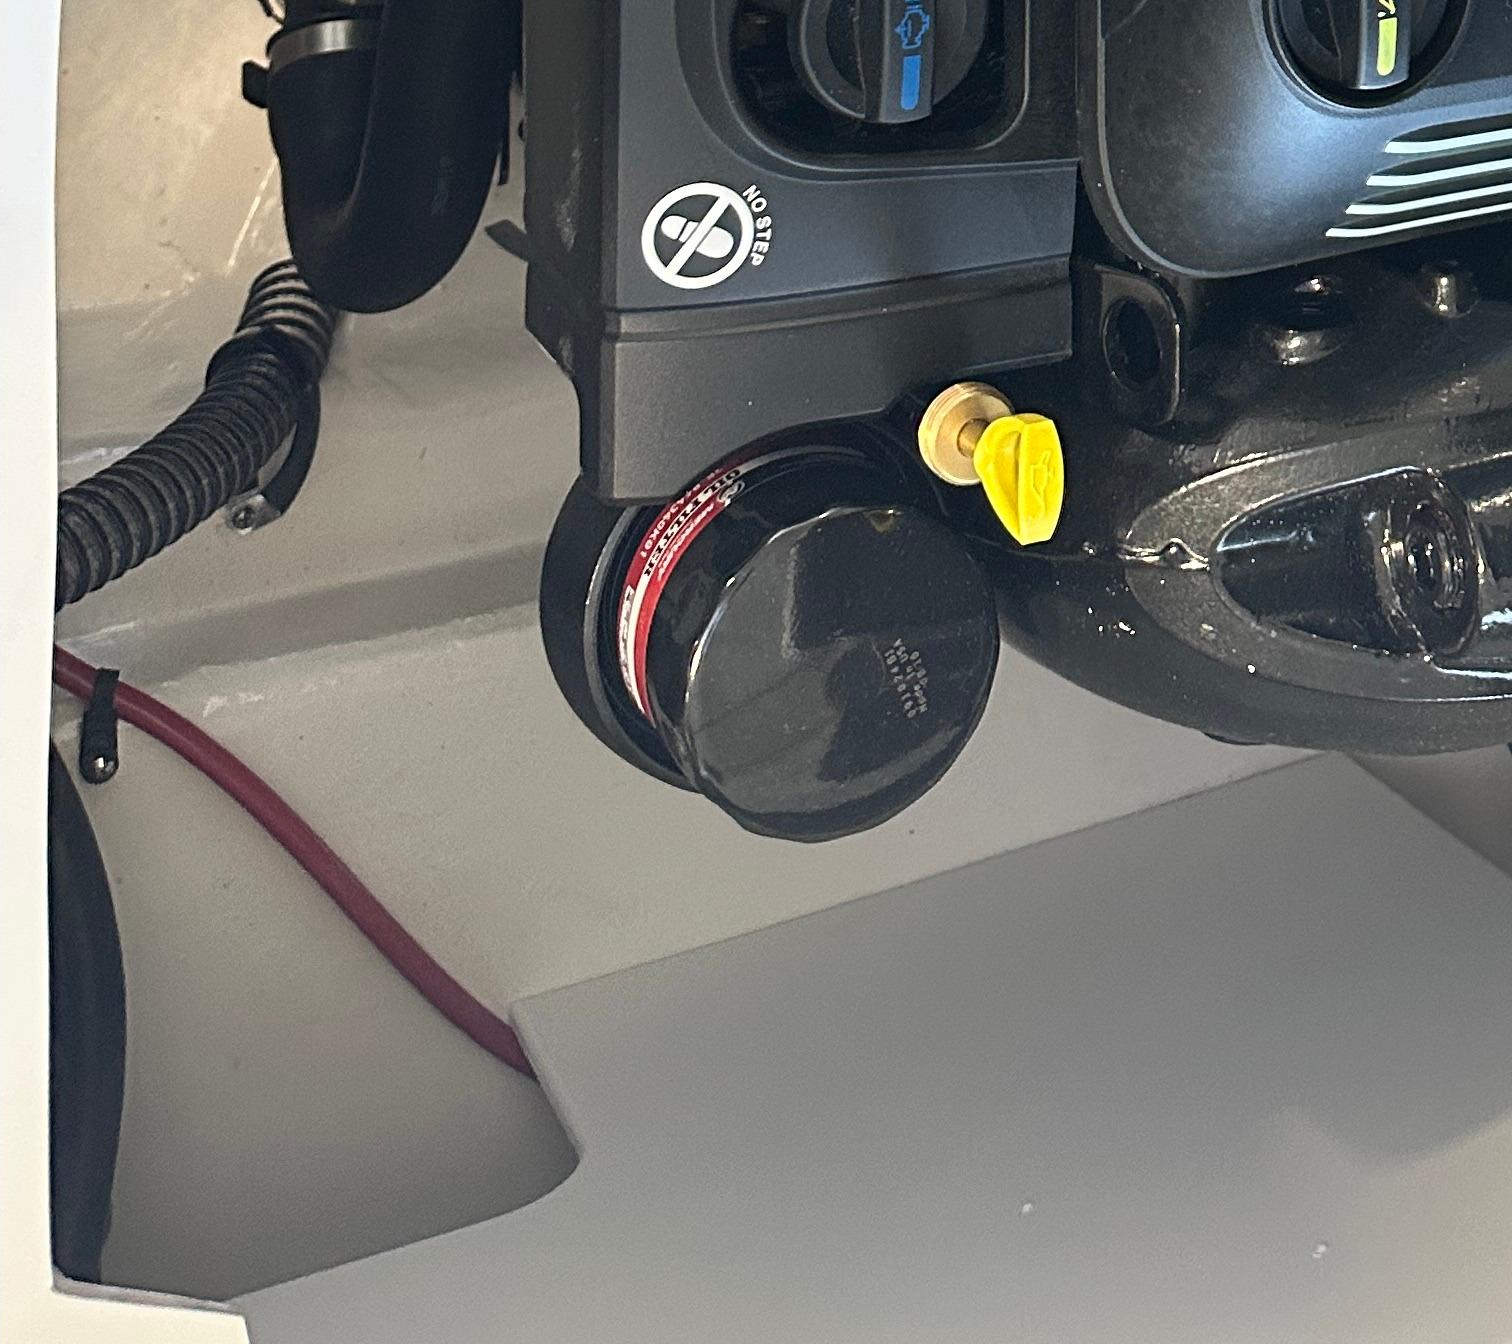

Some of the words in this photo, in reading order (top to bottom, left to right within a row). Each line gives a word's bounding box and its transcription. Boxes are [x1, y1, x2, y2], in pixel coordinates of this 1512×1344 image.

[742, 184, 767, 213] NO
[750, 215, 772, 266] STEP
[643, 498, 702, 577] FILTER
